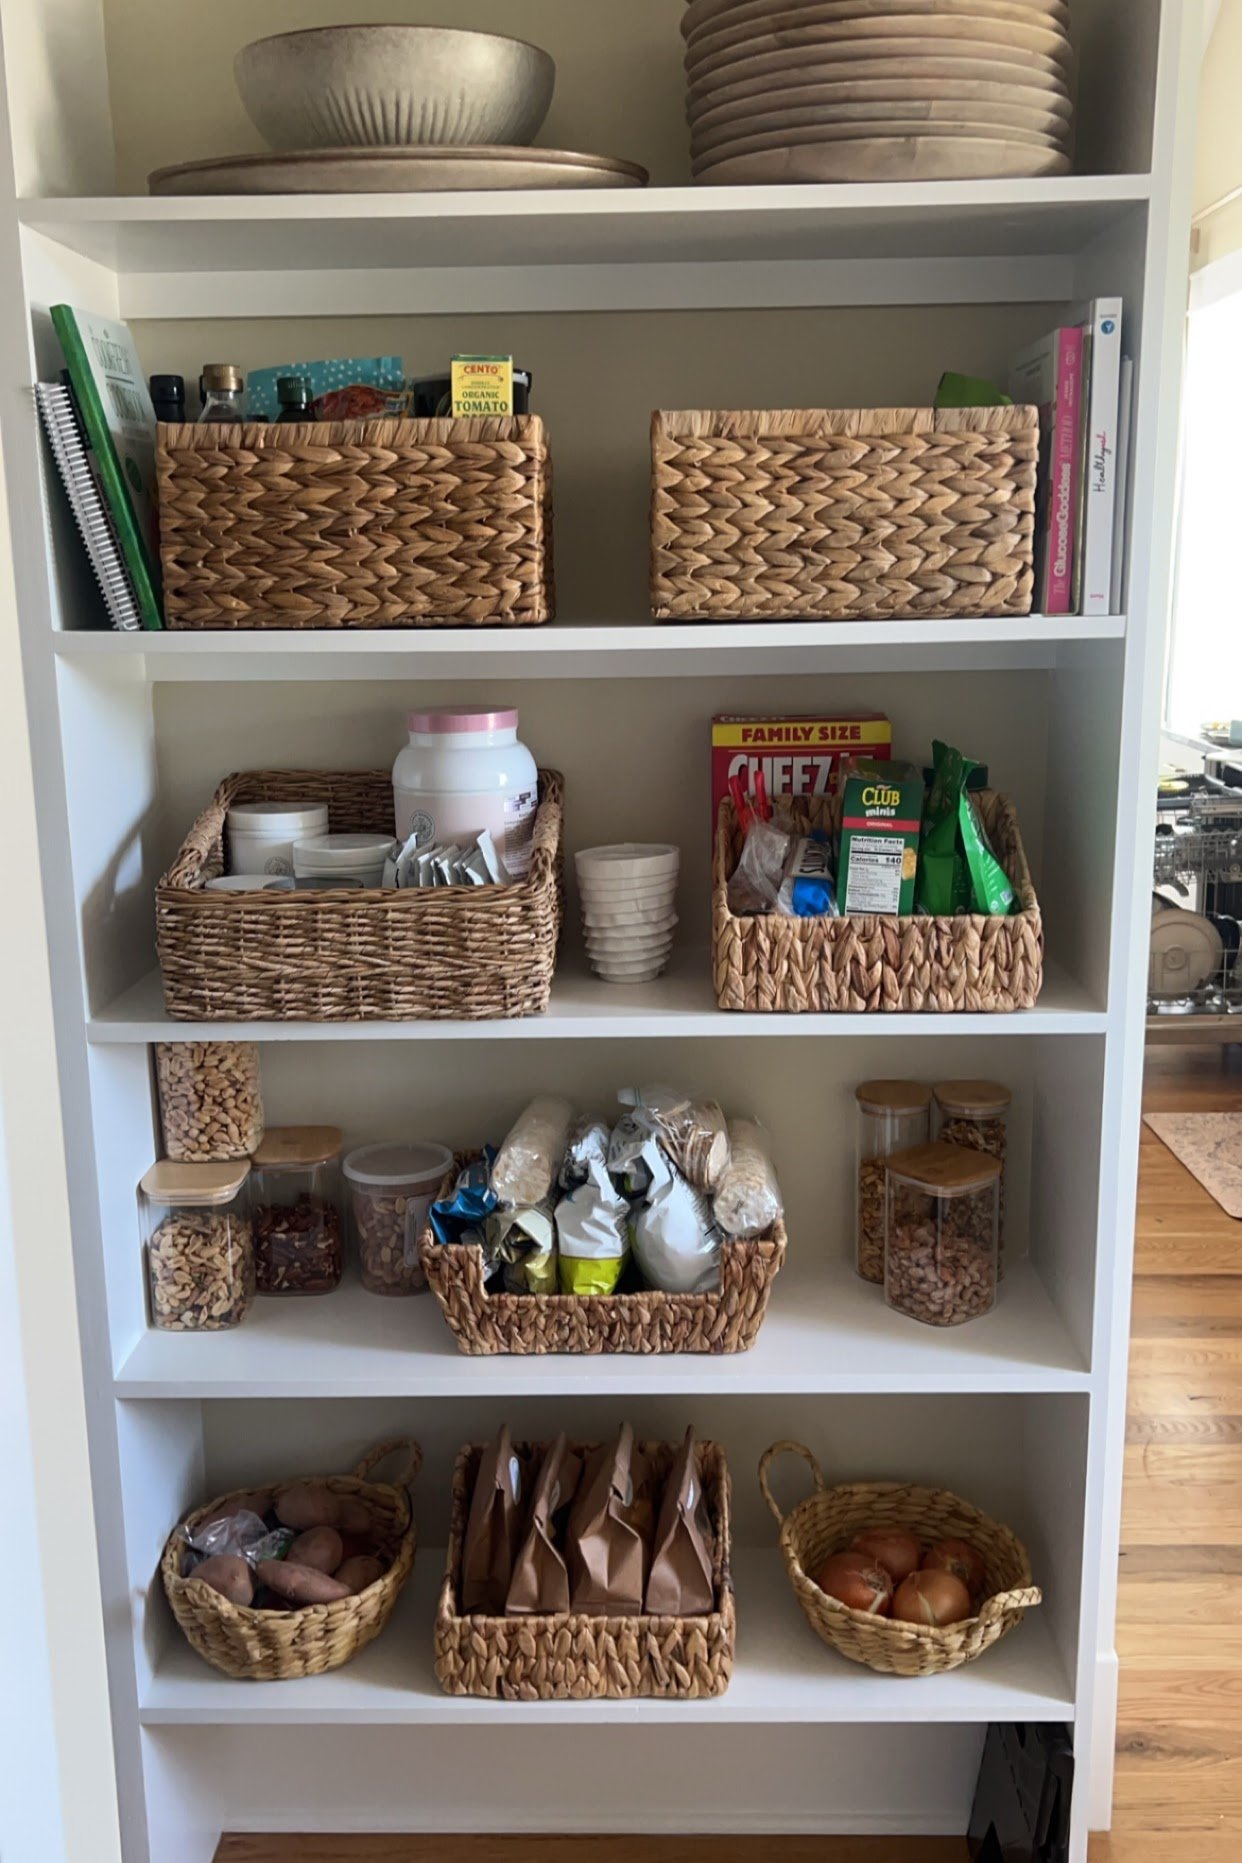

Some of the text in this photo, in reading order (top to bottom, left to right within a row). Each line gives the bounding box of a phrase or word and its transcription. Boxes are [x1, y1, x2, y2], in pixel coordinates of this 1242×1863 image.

[464, 364, 498, 375] CENTO
[462, 391, 500, 399] ORGANIC
[455, 401, 508, 412] TOMATO
[741, 725, 861, 743] FAMILY SIZE
[862, 787, 900, 806] CLUB
[865, 806, 896, 817] minis
